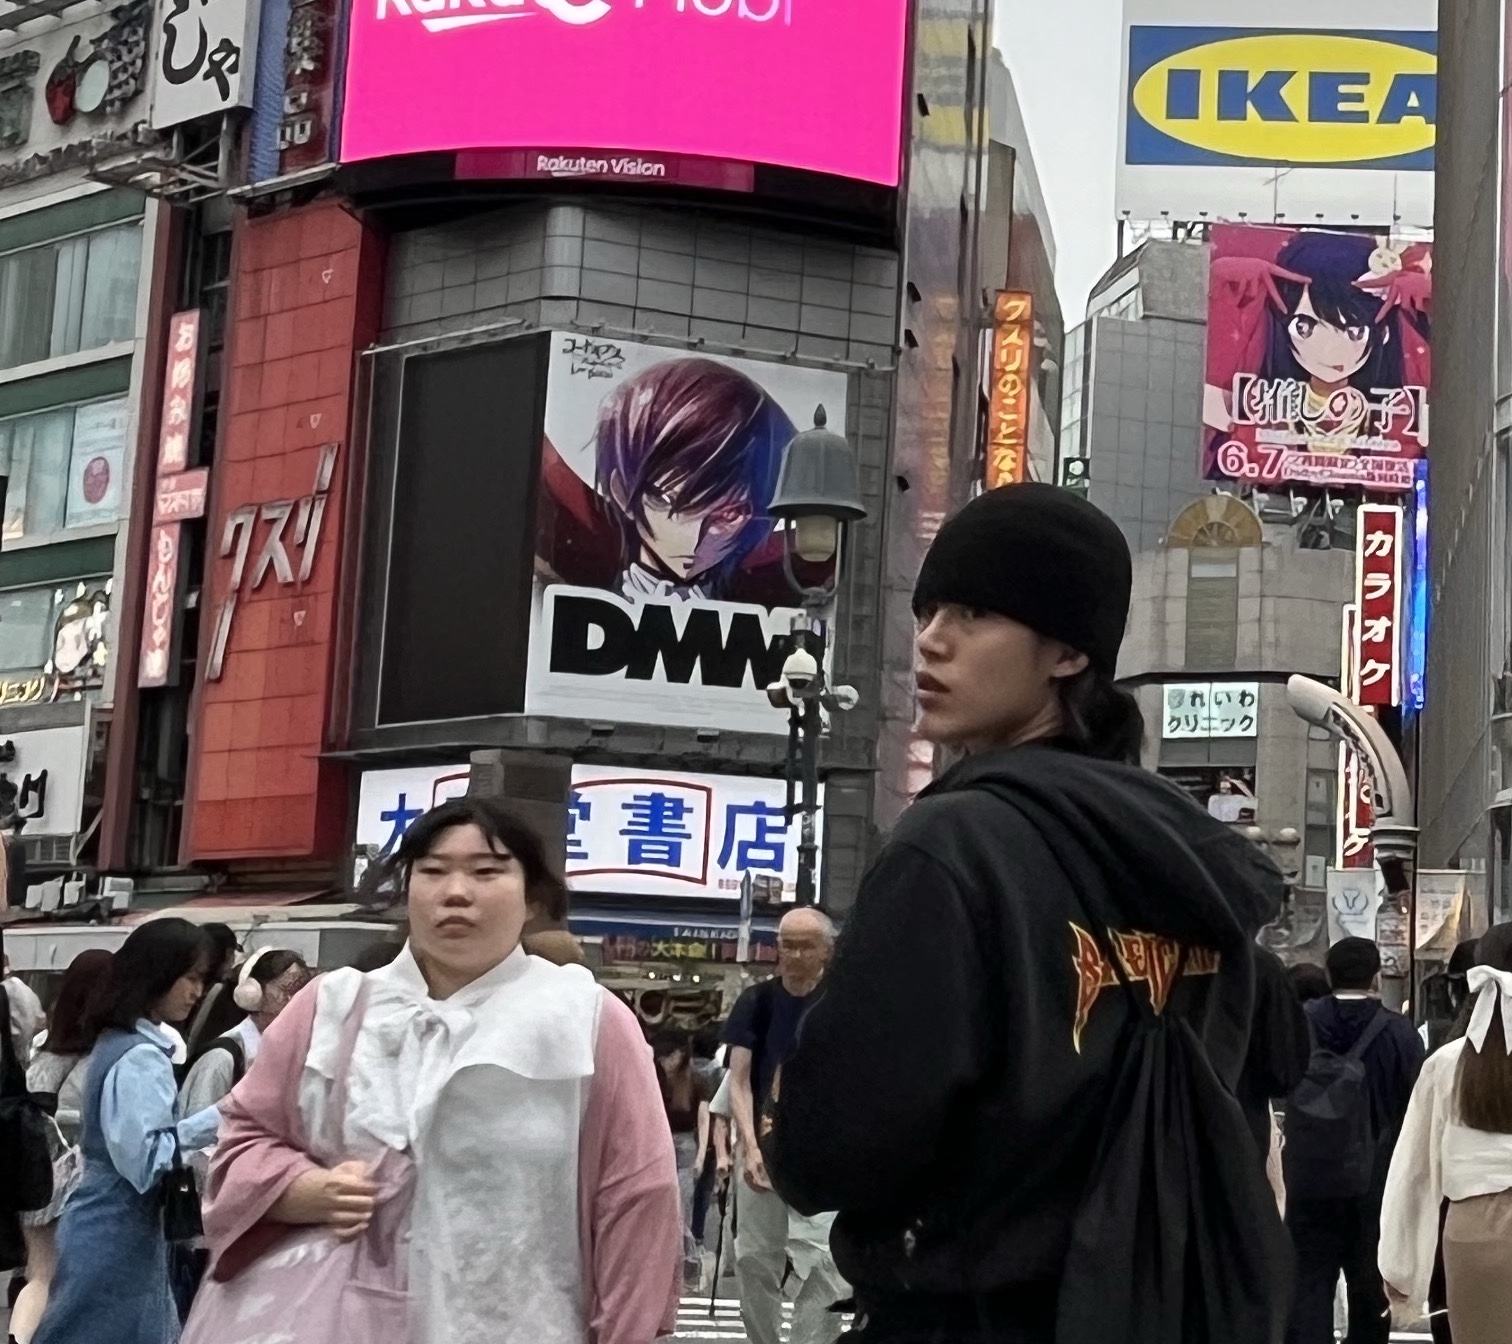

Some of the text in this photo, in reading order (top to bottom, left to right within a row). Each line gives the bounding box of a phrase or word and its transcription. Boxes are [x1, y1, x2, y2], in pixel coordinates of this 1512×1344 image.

[1165, 69, 1437, 125] IKEA
[537, 155, 665, 177] Rakuten Vision
[1360, 530, 1394, 686] カラオケ
